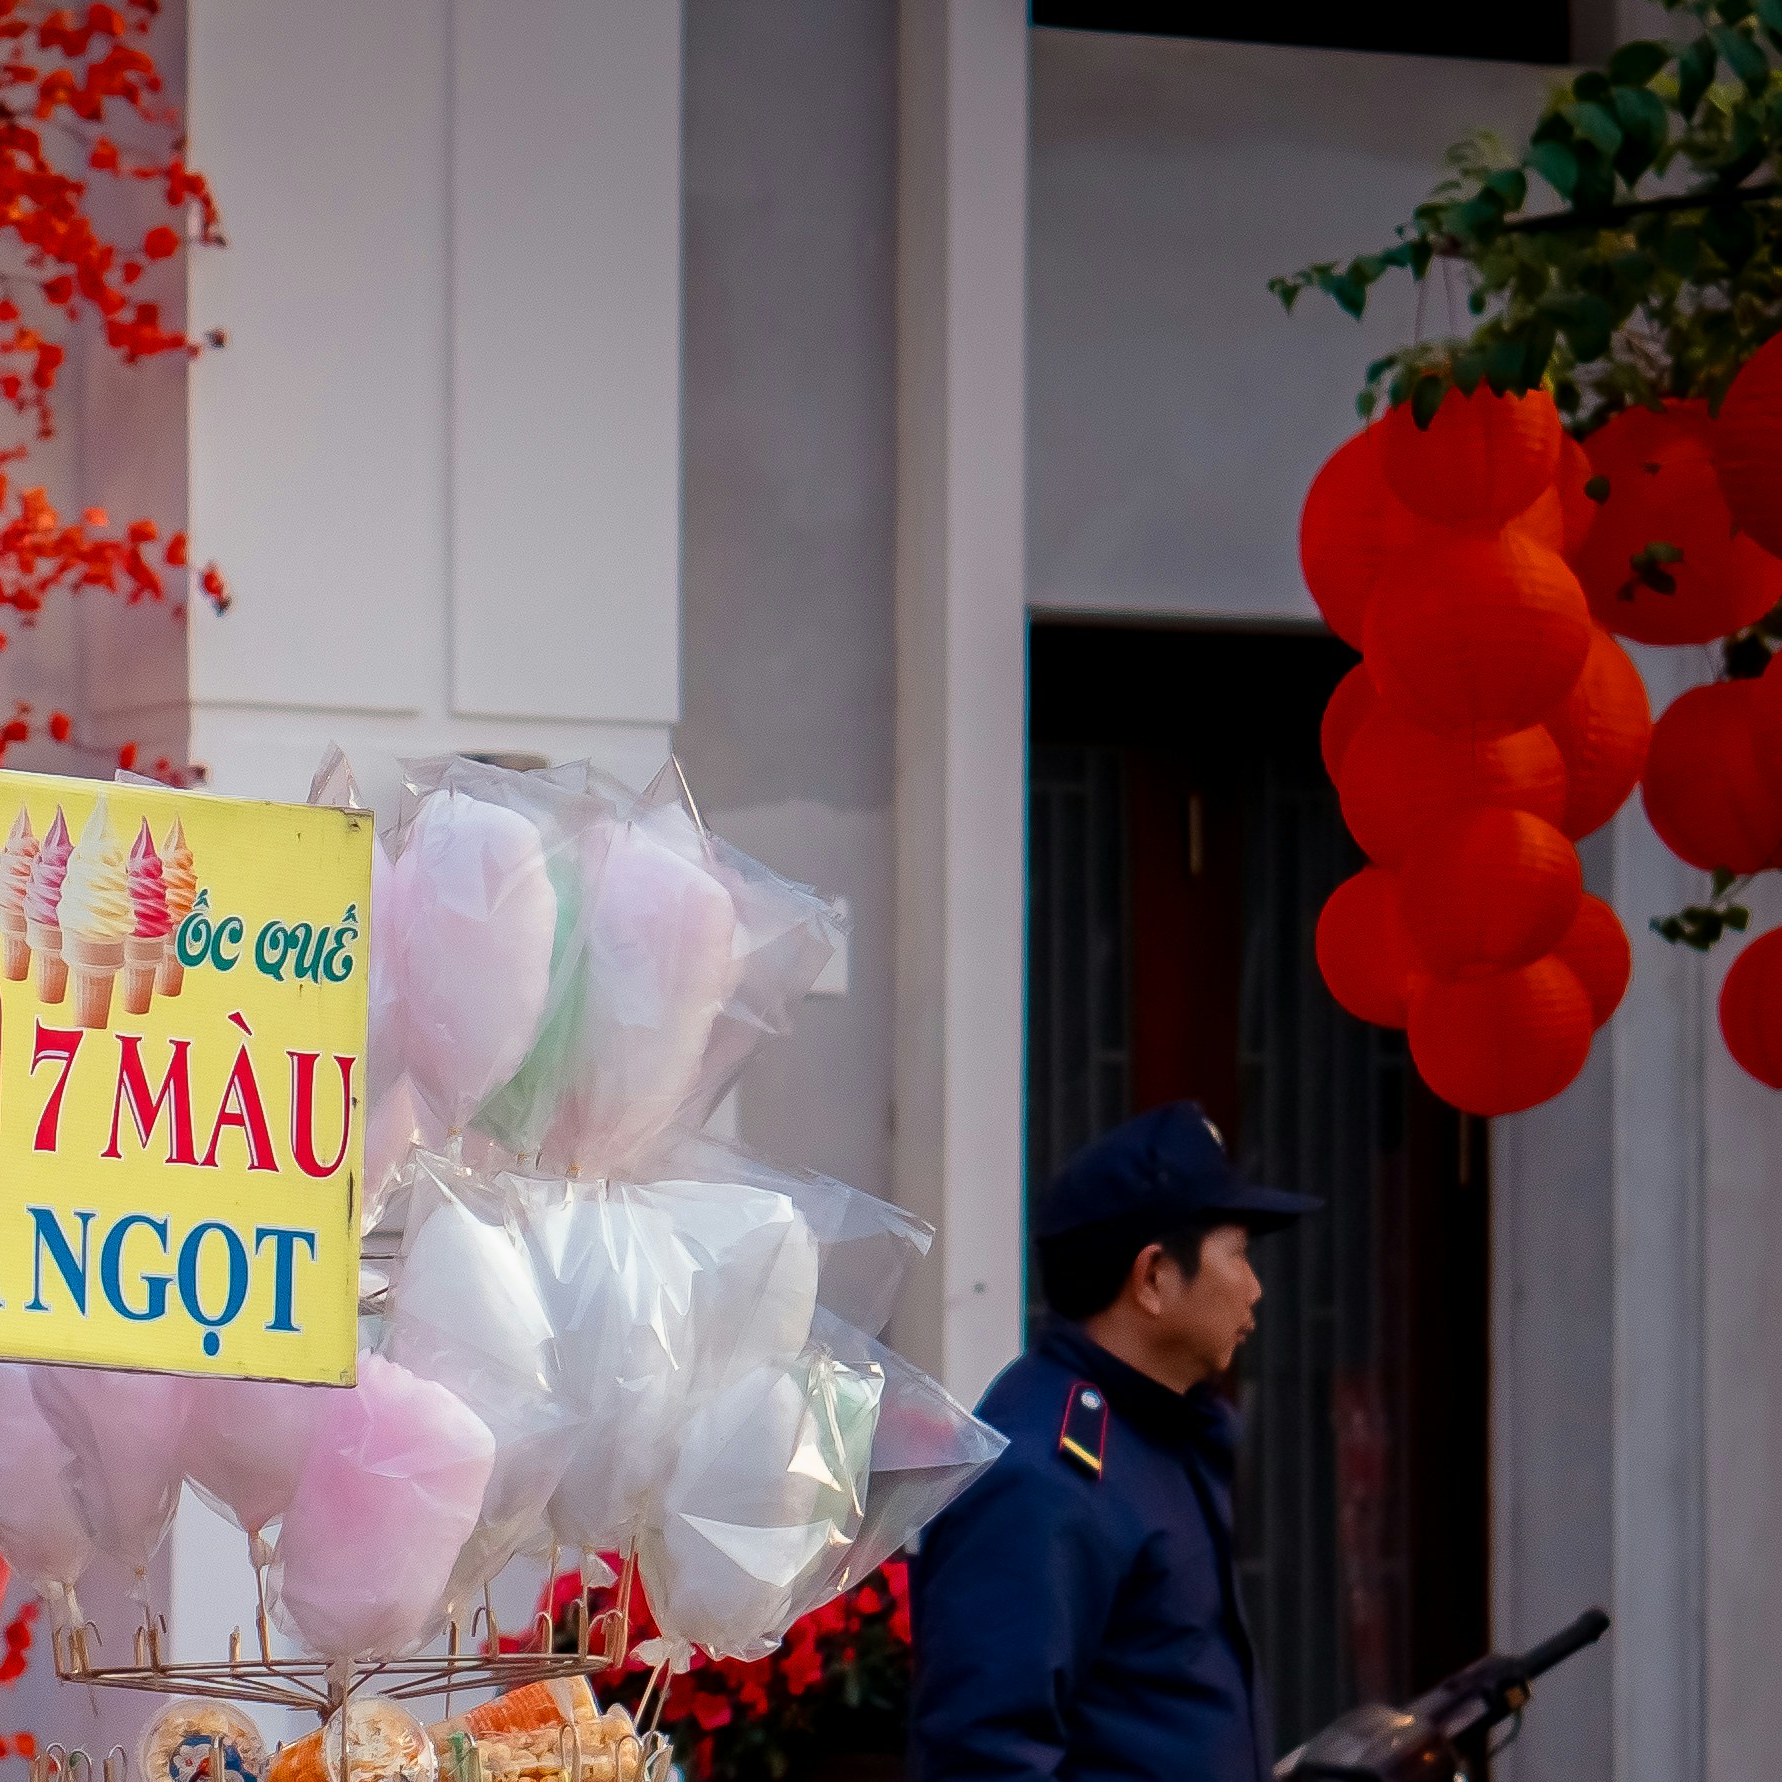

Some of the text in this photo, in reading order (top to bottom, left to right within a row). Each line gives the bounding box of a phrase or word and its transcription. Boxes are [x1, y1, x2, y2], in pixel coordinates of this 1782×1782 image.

[177, 886, 360, 984] ỐC QUẾ
[30, 1010, 357, 1178] 7 MÀU
[22, 1206, 318, 1357] NGỌT
